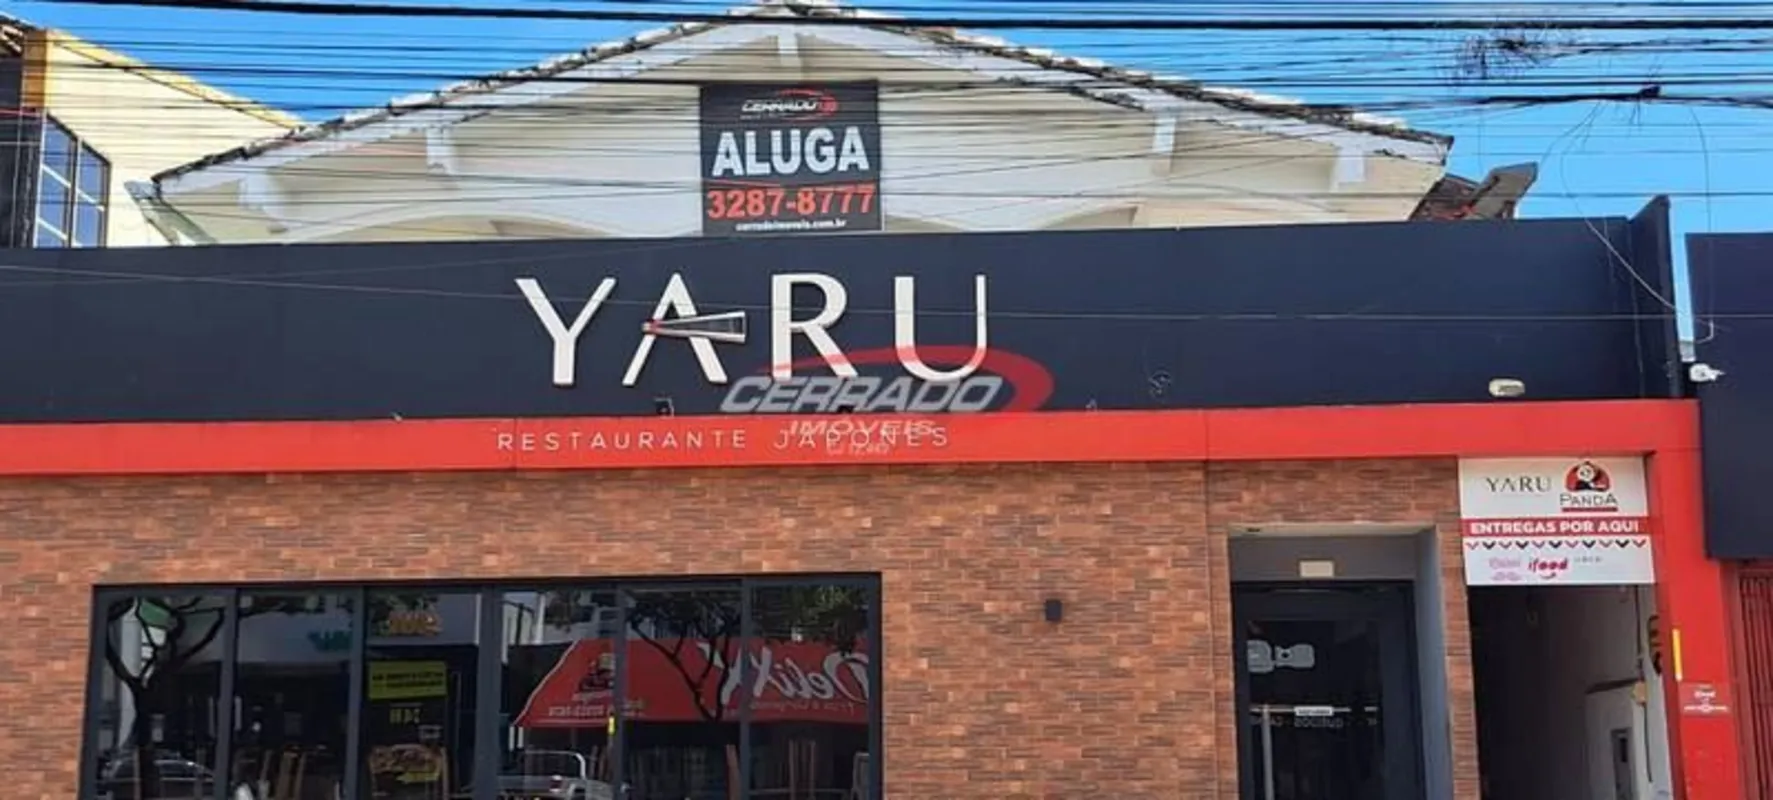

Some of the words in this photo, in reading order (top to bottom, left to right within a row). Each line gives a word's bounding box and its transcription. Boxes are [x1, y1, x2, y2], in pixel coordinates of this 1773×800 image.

[712, 126, 870, 176] ALUGA
[707, 184, 875, 219] 3287-8777
[513, 271, 989, 387] YARU
[498, 430, 746, 451] RESTAURANTE
[1486, 476, 1551, 492] YARU
[1470, 520, 1557, 534] ENTREGAS
[1560, 520, 1594, 533] POR
[1597, 519, 1639, 533] AQUI
